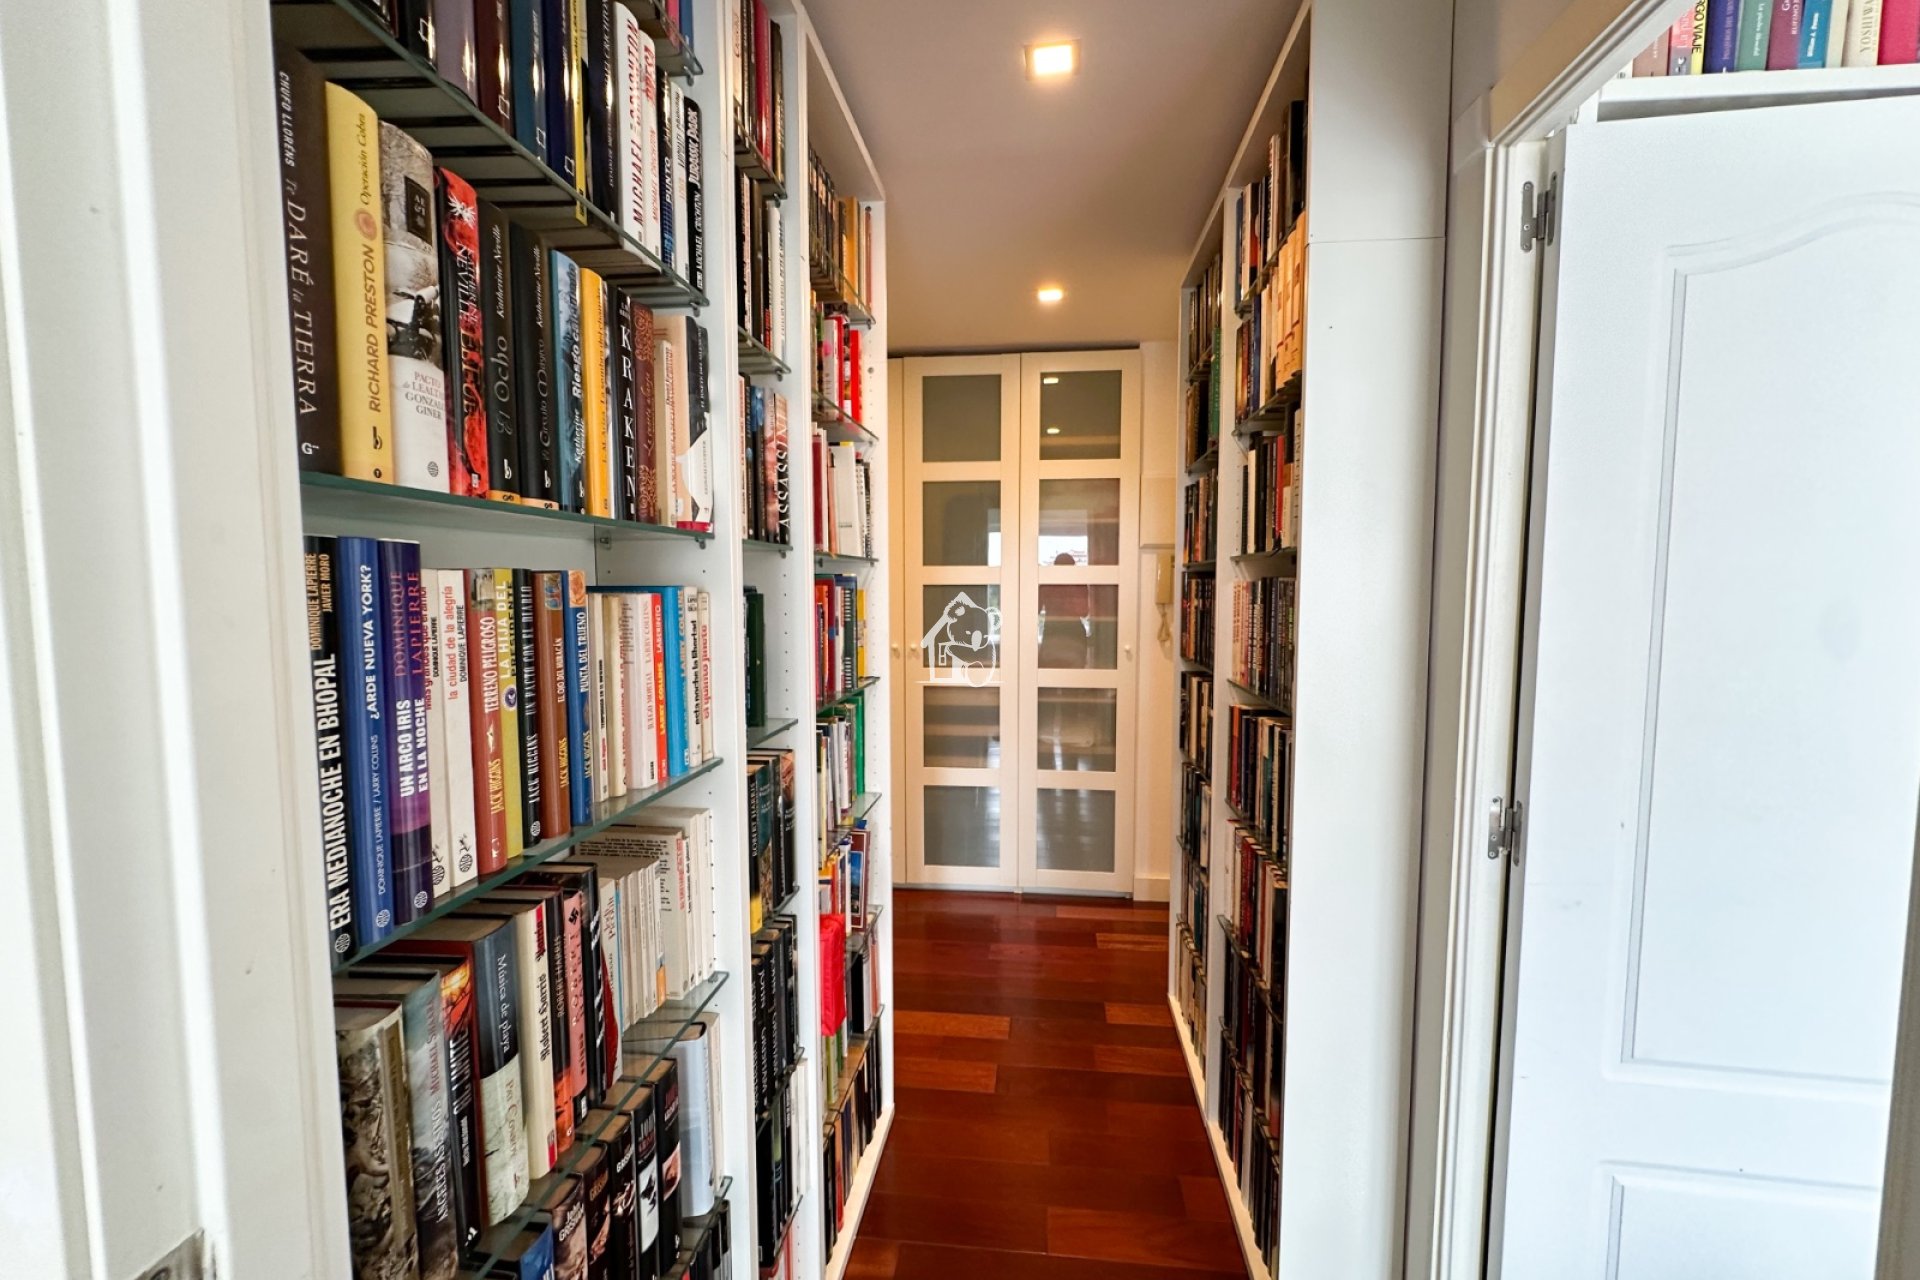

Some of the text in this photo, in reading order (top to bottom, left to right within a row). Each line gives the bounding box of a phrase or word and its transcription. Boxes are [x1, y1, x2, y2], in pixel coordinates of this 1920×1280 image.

[1690, 0, 1706, 54] RGO VIAJE
[279, 71, 295, 167] CHUFO LLORÉNS
[686, 107, 701, 189] JURASSIC PARK
[356, 112, 371, 206] Operación Cobra
[630, 139, 644, 227] MICHAEL
[664, 156, 673, 204] PUNTO
[287, 200, 313, 286] DARÉ
[693, 190, 703, 232] CRICHTON
[455, 241, 470, 321] NEVILLE
[467, 247, 479, 325] KATHERINE
[491, 224, 505, 320] Katherine Neville
[533, 244, 545, 329] Katherine Neville
[294, 310, 318, 415] TIERRA
[362, 243, 382, 413] RICHARD PRESTON
[405, 391, 443, 410] GONZAL
[412, 381, 440, 398] LEALT
[414, 371, 441, 388] PACTO
[490, 335, 510, 403] Ocho
[570, 344, 583, 399] Riesgo
[415, 405, 442, 420] GINER
[572, 408, 583, 465] Katherine
[619, 325, 637, 496] KRAKEN
[304, 553, 322, 651] DOMINIQUE LAPIERRE
[318, 553, 333, 613] JAVIER MORO
[360, 564, 380, 720] ¿ARDE NUEVA YORK?
[390, 571, 406, 677] DOMINIQUE
[407, 572, 423, 676] LAPIERRE
[430, 617, 440, 678] DOMINIQUE LAPIERRE
[441, 585, 458, 700] la ciudad de la alegría
[456, 604, 467, 683] DOMINIQUE LAPIERRE
[496, 581, 510, 680] LA HIJA DEL
[506, 581, 516, 677] PRESIDENTE
[520, 585, 537, 716] UN PACTO CON EL DIABLO
[576, 611, 589, 693] PUNTA DEL TRUENO
[691, 619, 699, 659] libertad
[480, 616, 500, 713] TERRENO PELIGROSO
[553, 637, 565, 703] EL OJO DEL HURACÁN
[692, 659, 699, 670] la
[692, 670, 700, 702] noche
[702, 663, 710, 705] quinto
[370, 734, 379, 770] COLLINS
[396, 699, 415, 798] UN ARCO IRIS
[415, 698, 429, 792] EN LA NOCHE
[703, 706, 709, 719] el
[313, 653, 351, 931] ERA MEDIANOCHE EN BHOPAL
[371, 772, 381, 798] LARRY
[488, 758, 503, 814] JACK HIGGINS
[526, 733, 540, 804] JACK HIGGINS
[558, 737, 569, 788] JACK HIGGINS
[582, 730, 592, 779] JACK HIGGINS
[373, 806, 384, 844] LAPIERRE
[375, 844, 386, 895] DOMINIQUE
[495, 954, 511, 1054] Música de playa
[554, 934, 565, 1018] ROBERT HARRIS
[537, 973, 551, 1062] Robert Harris
